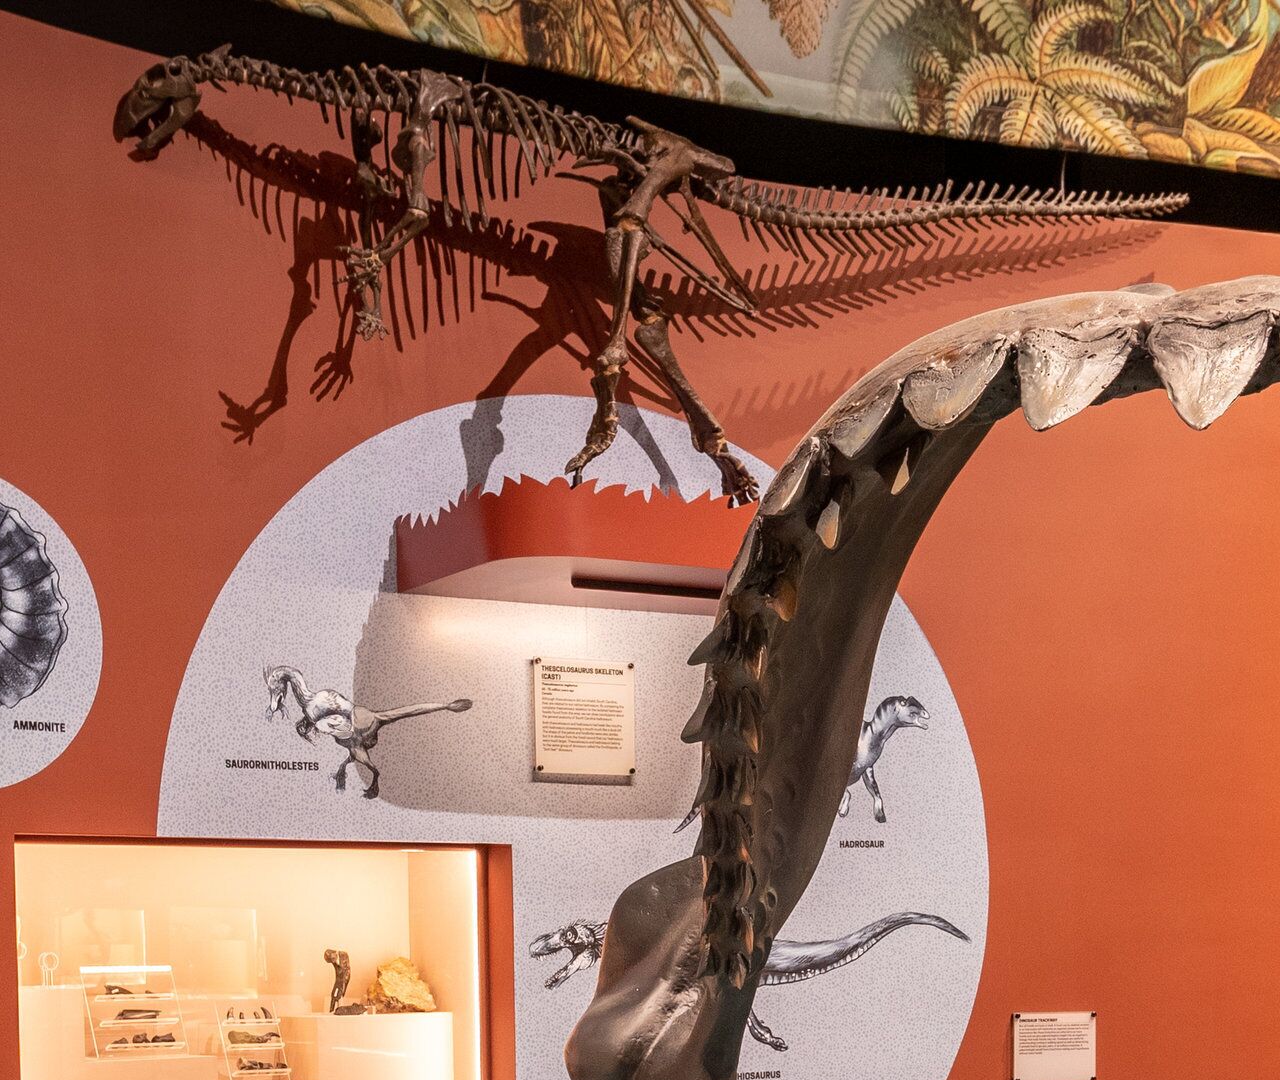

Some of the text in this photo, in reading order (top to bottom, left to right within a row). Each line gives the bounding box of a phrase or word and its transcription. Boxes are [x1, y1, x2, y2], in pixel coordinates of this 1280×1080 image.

[541, 665, 624, 676] THESCELOSAURUS SKELETON
[13, 720, 66, 733] AMMONITE
[225, 758, 319, 771] SAURORNITHOLESTES
[839, 840, 885, 850] HADROSAUR
